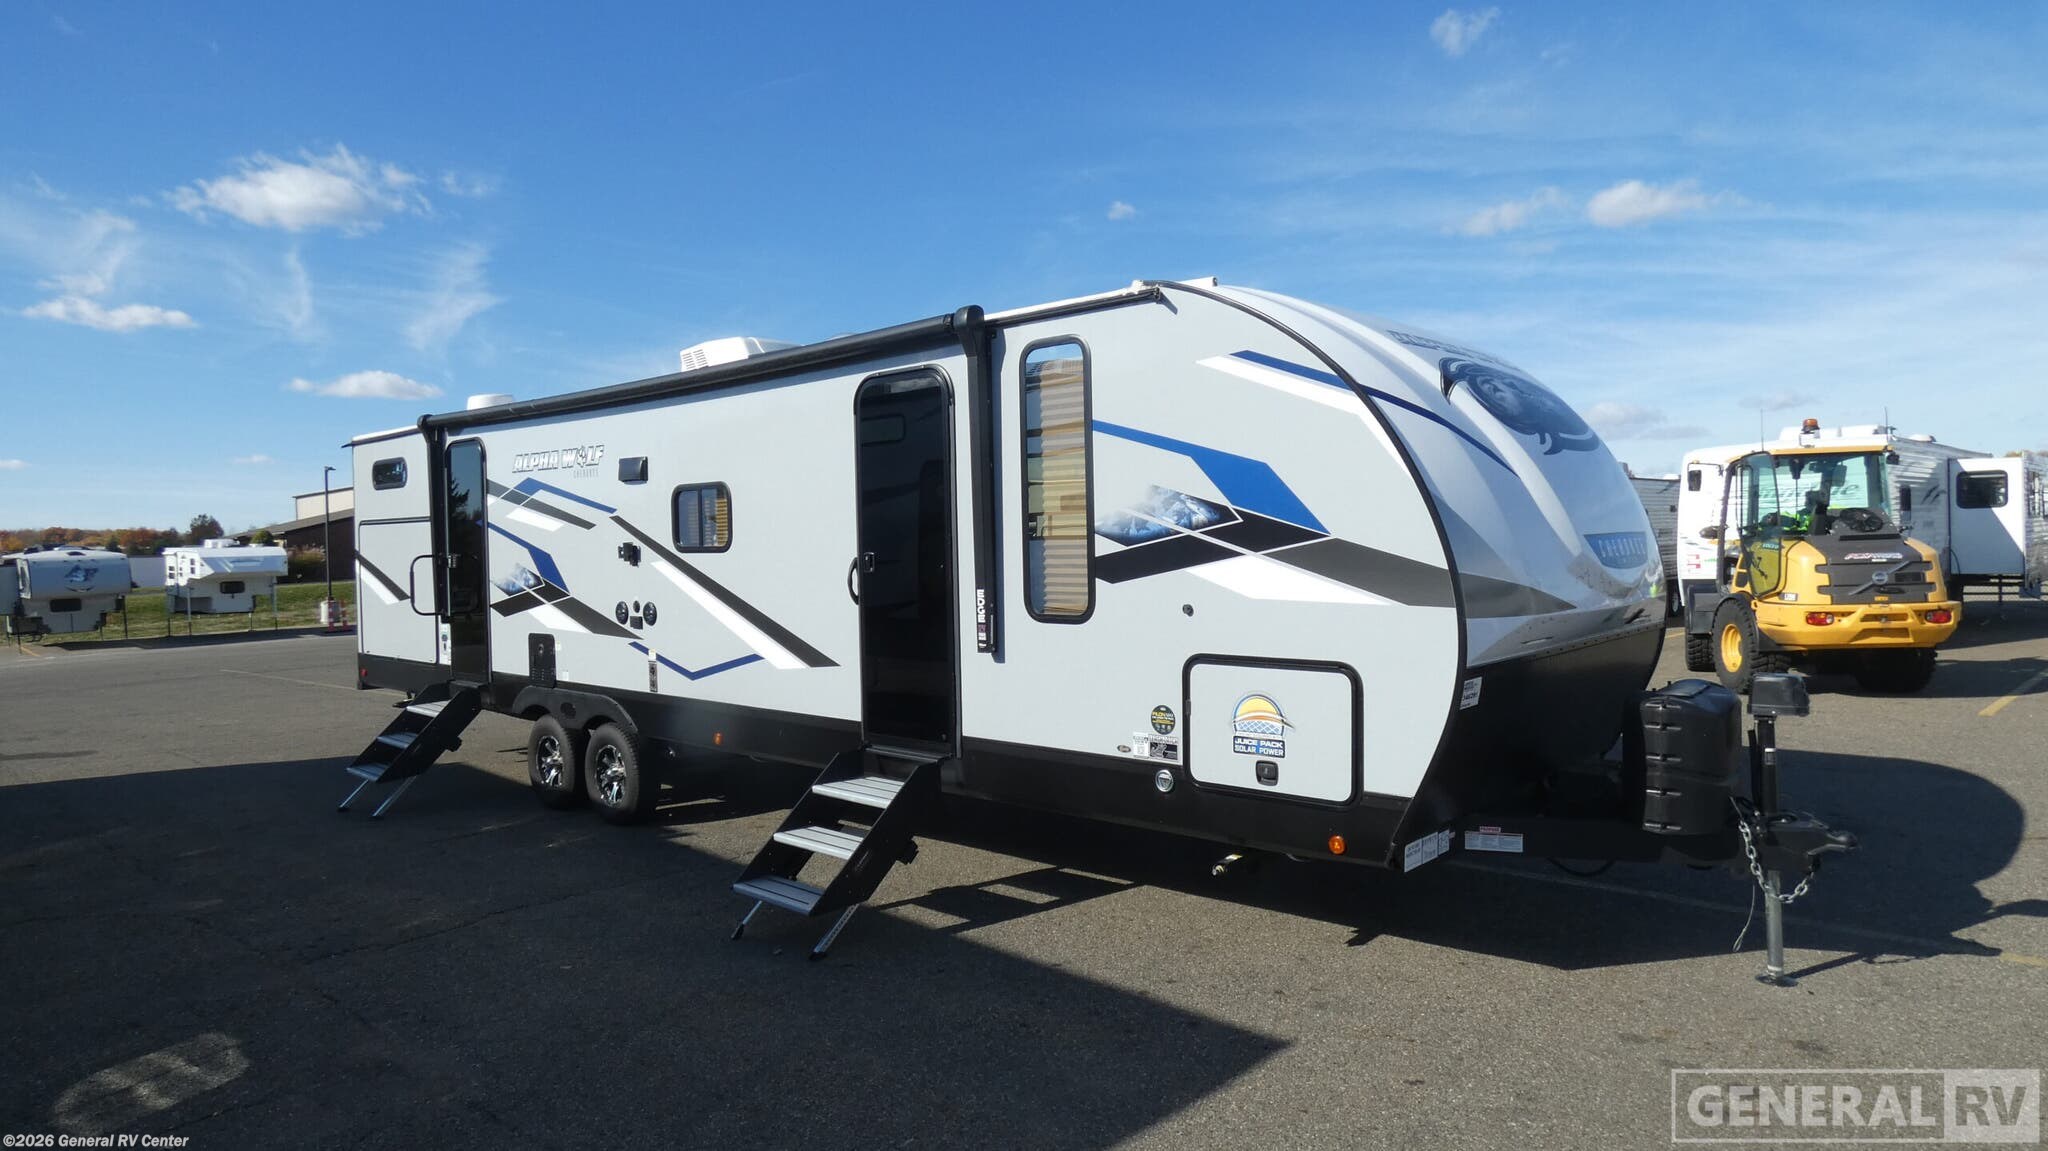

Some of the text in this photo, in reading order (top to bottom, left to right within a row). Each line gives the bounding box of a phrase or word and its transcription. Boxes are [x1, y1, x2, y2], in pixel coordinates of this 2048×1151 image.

[512, 449, 560, 473] ALPHA
[1234, 737, 1284, 749] JUICE PACK
[1234, 745, 1284, 756] SOLAR POWER
